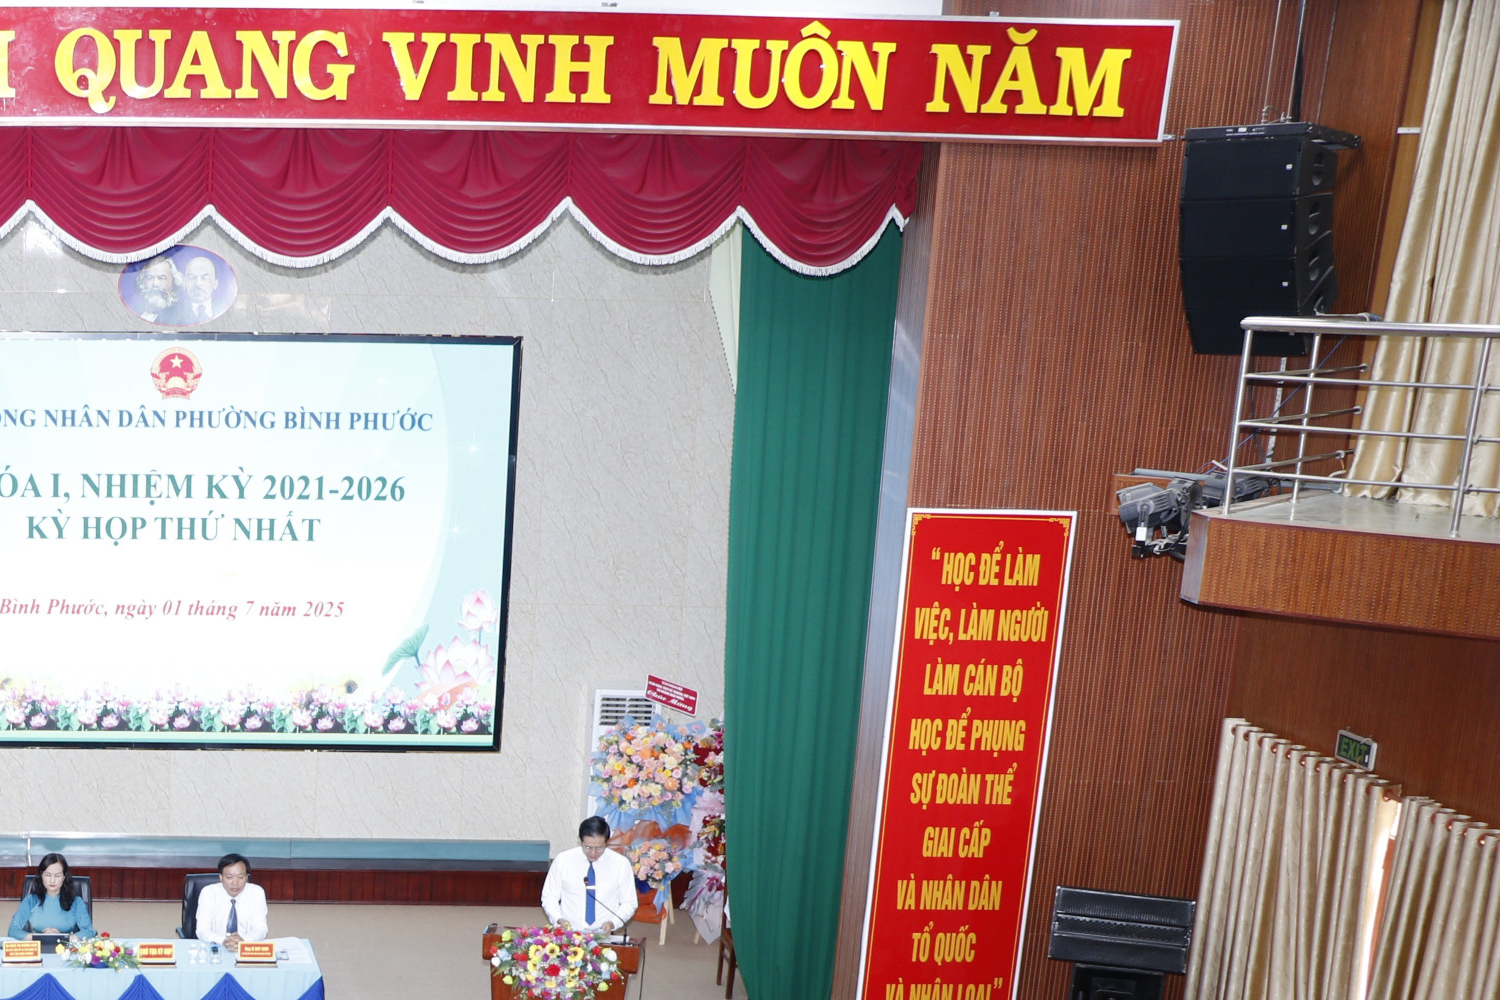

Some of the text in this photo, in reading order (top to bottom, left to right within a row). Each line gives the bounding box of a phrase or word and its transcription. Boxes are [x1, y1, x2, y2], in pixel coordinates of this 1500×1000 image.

[55, 28, 355, 113] QUANG
[382, 32, 614, 103] VINH
[649, 20, 896, 110] MUÔN
[926, 27, 1132, 117] NĂM
[45, 404, 110, 427] NHÂN
[119, 405, 165, 427] DÂN
[176, 406, 275, 429] PHƯỜNG
[285, 406, 340, 429] BÌNH
[350, 408, 432, 431] PHƯỚC
[52, 474, 69, 501] I,
[82, 470, 192, 505] NHIỆM
[207, 467, 252, 499] KỲ
[263, 475, 404, 501] 2021-2026
[28, 509, 320, 546] KỲ HỌP THỨ NHẤT
[978, 541, 1004, 585] ĐỂ
[1004, 547, 1041, 586] LÀM
[0, 599, 344, 619] Bình Phước, ngày 01 tháng 7 năm 2025
[914, 601, 1049, 645] VIỆC, LÀM NGƯỜI
[923, 657, 1024, 702] LÀM CÁN BỘ
[909, 707, 1026, 757] HỌC ĐỂ PHỤNG
[1341, 736, 1368, 764] EXIT
[910, 762, 1017, 810] SỰ ĐOÀN THỂ
[922, 820, 991, 858] GIAI CẤP
[897, 873, 1002, 910] VÀ NHÂN DÂN
[912, 921, 976, 966] TỔ QUỐC
